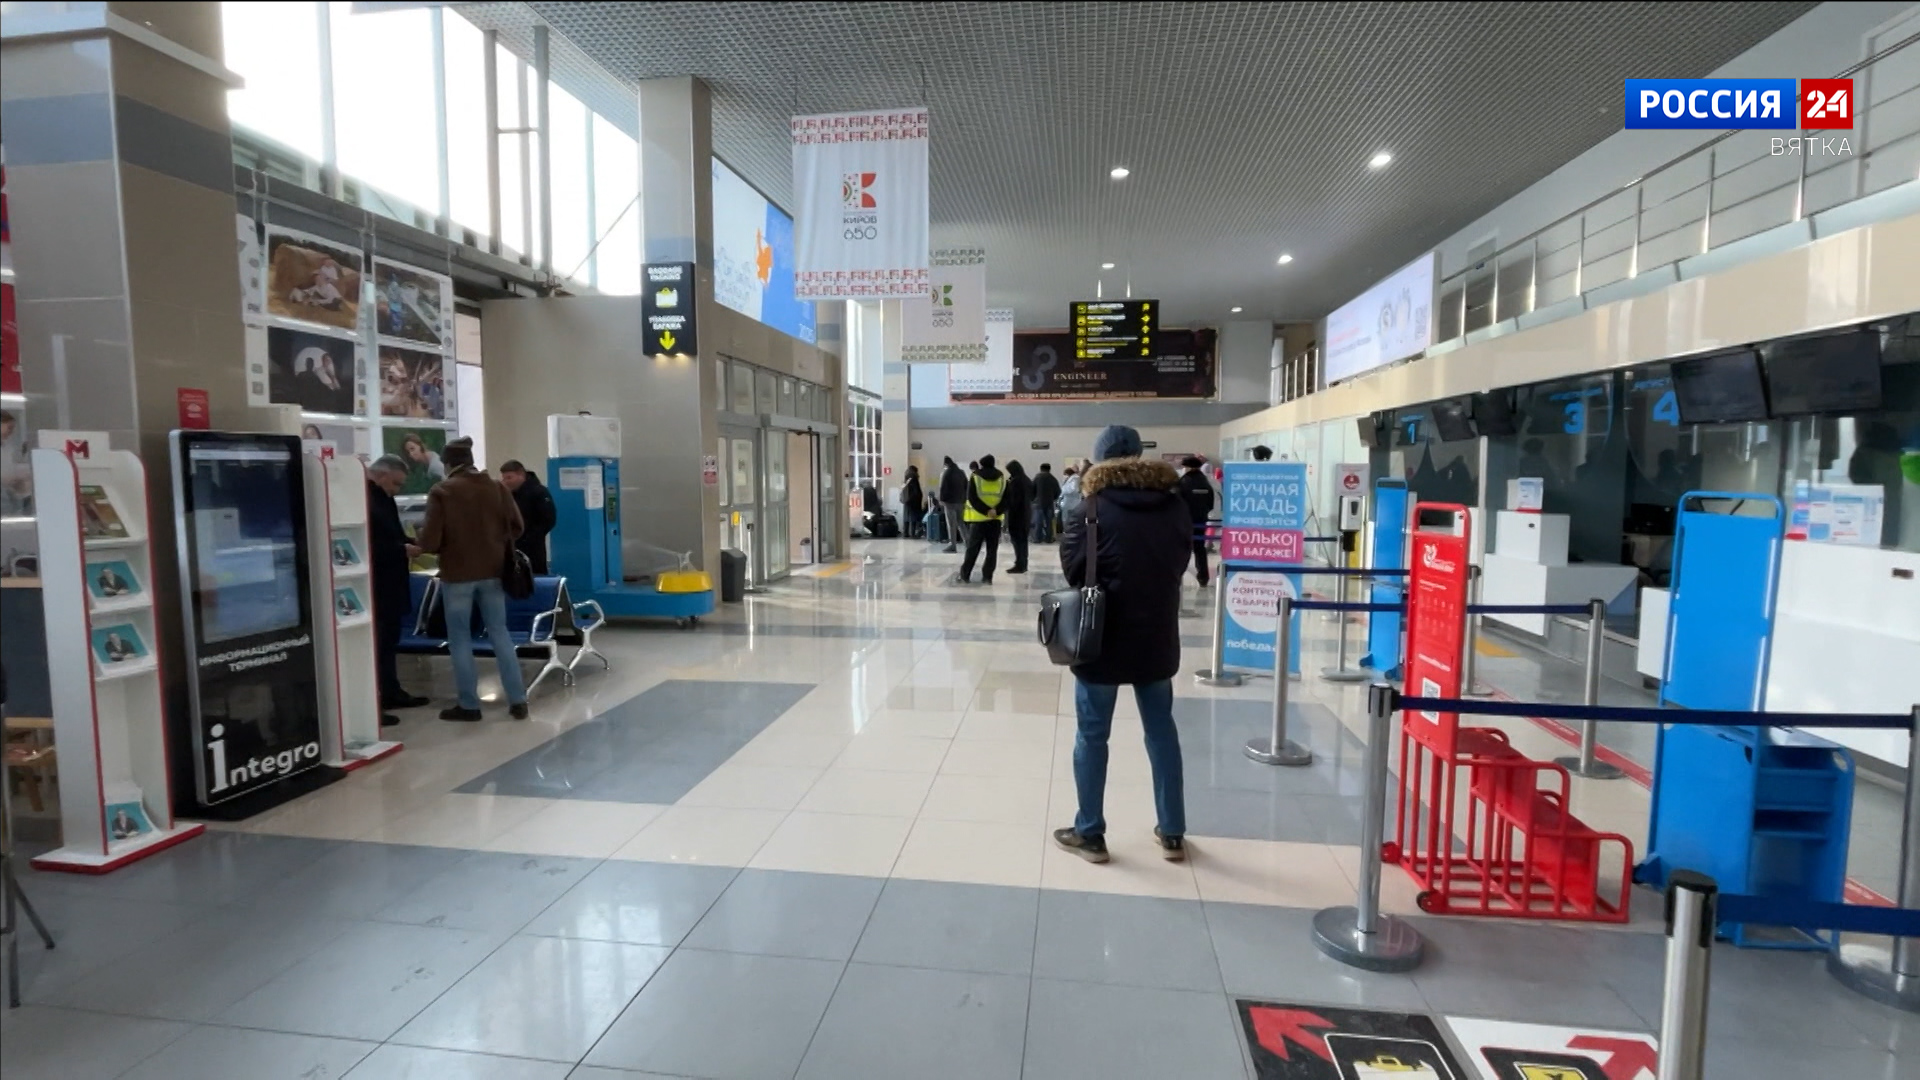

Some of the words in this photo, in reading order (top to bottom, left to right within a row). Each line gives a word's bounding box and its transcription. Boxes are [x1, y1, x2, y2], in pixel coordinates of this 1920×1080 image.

[843, 216, 877, 224] КИРОВ
[843, 226, 877, 240] 650
[1652, 390, 1680, 426] 4
[1564, 401, 1585, 434] 3
[1230, 483, 1299, 496] РУЧНАЯ
[1230, 498, 1298, 515] КЛАДЬ
[1229, 531, 1292, 546] ТОЛЬКО
[1232, 546, 1240, 556] В
[207, 723, 320, 795] integro
